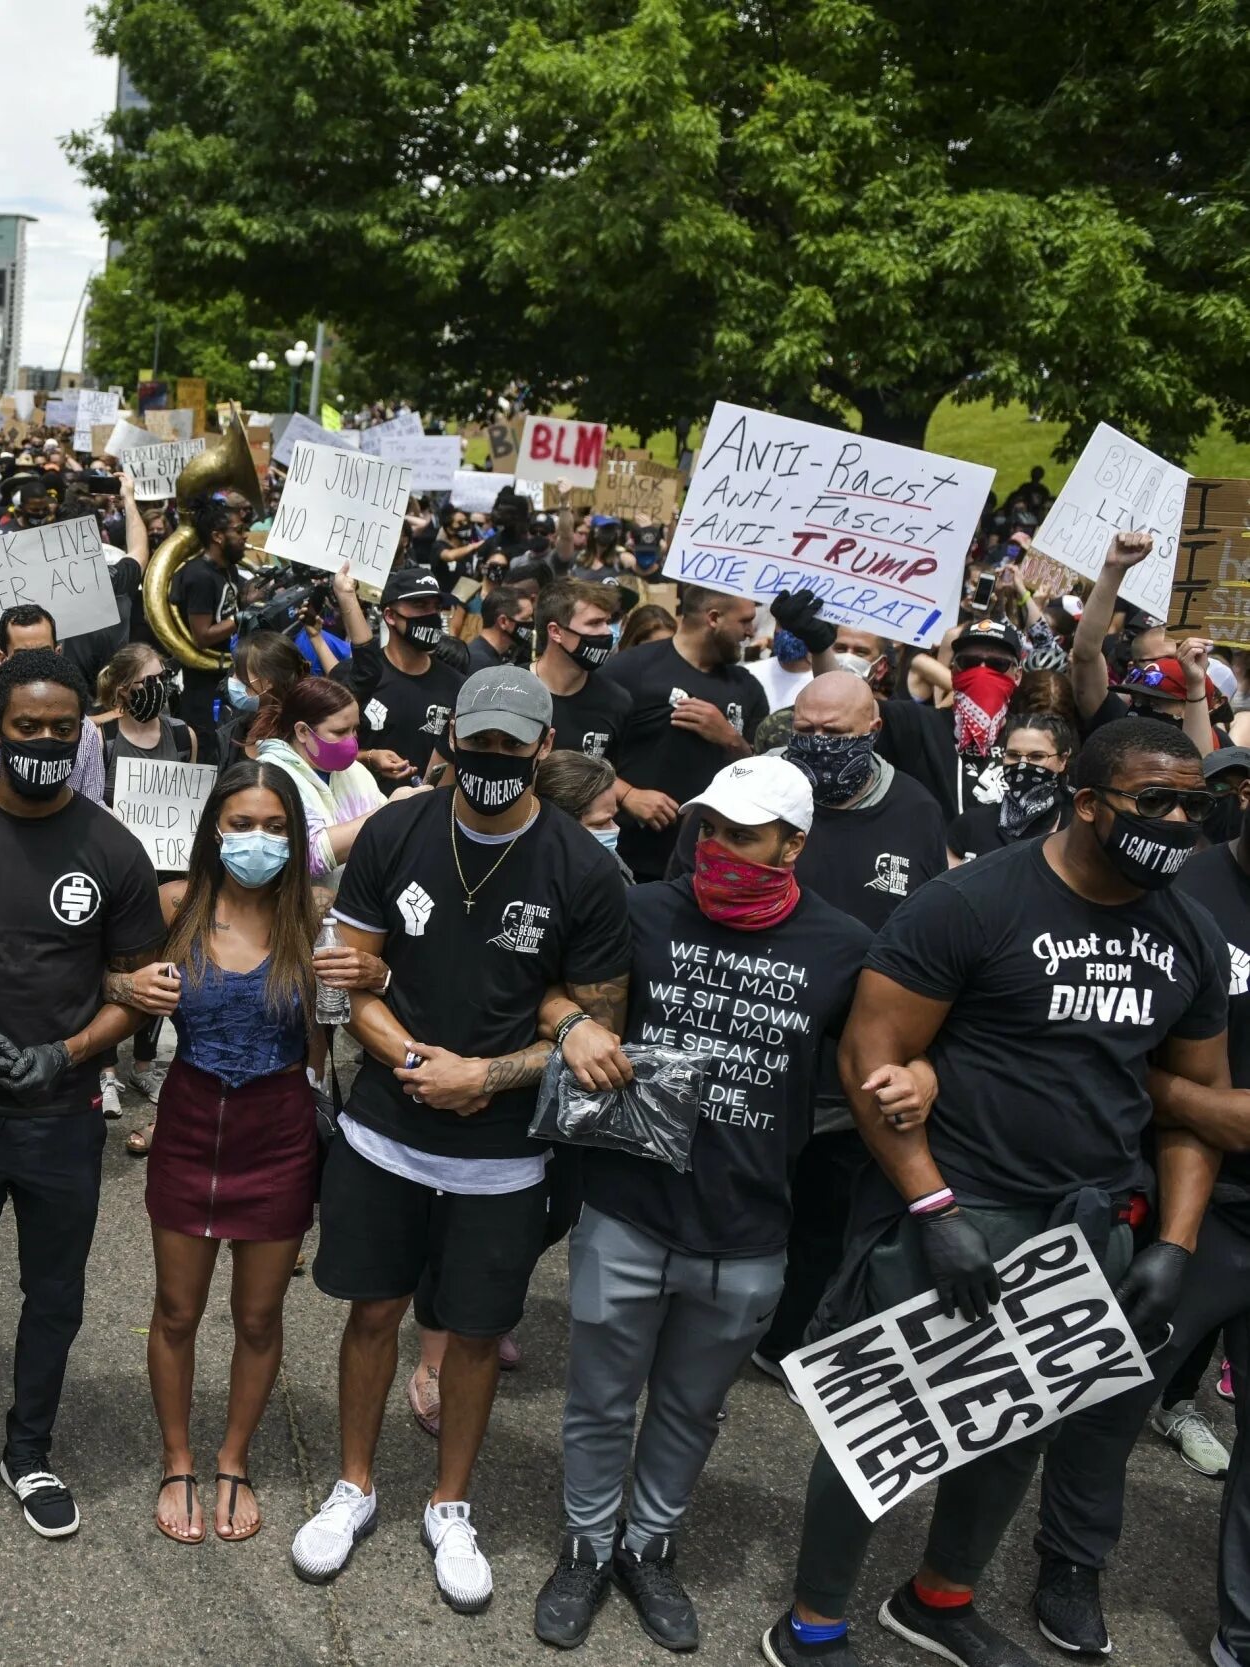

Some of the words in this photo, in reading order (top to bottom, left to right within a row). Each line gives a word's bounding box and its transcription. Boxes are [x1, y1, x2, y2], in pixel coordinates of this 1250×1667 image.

[529, 422, 604, 469] BLM
[130, 462, 148, 478] WE
[289, 445, 315, 486] NO
[325, 453, 413, 518] JUSTICE
[607, 474, 664, 492] BLACK
[38, 518, 103, 563] LIVES
[273, 503, 308, 543] NO
[325, 514, 391, 572] PEACE
[50, 554, 102, 600] ACT
[680, 550, 749, 584] VOTE
[13, 755, 39, 784] CAN'T
[461, 772, 483, 802] CAN'T
[483, 776, 525, 805] BREATHE
[117, 800, 180, 829] SHOULD
[1119, 832, 1129, 849] I
[1125, 836, 1166, 870] CAN'T
[520, 913, 535, 926] FOR
[521, 902, 551, 919] JUSTICE
[516, 936, 539, 948] FLOYD
[518, 924, 546, 940] GEORGE
[671, 940, 710, 964] WE
[715, 949, 809, 988] MARCH,
[1032, 932, 1101, 976] Just
[1105, 938, 1126, 957] a
[1129, 926, 1178, 982] Kid
[1085, 963, 1132, 982] FROM
[671, 960, 733, 990] Y'ALL
[739, 974, 799, 1005] MAD.
[649, 980, 687, 1005] WE
[691, 989, 730, 1012] SIT
[733, 998, 810, 1035] DOWN,
[661, 1003, 723, 1033] Y'ALL
[728, 1020, 785, 1048] MAD.
[1047, 984, 1156, 1026] DUVAL
[642, 1022, 677, 1047] WE
[681, 1032, 760, 1065] SPEAK
[764, 1050, 790, 1073] UP,
[718, 1061, 775, 1089] MAD.
[708, 1084, 749, 1111] DIE,
[997, 1234, 1143, 1415] BLACK
[895, 1300, 1045, 1453] LIVES
[799, 1324, 950, 1507] MATTER
